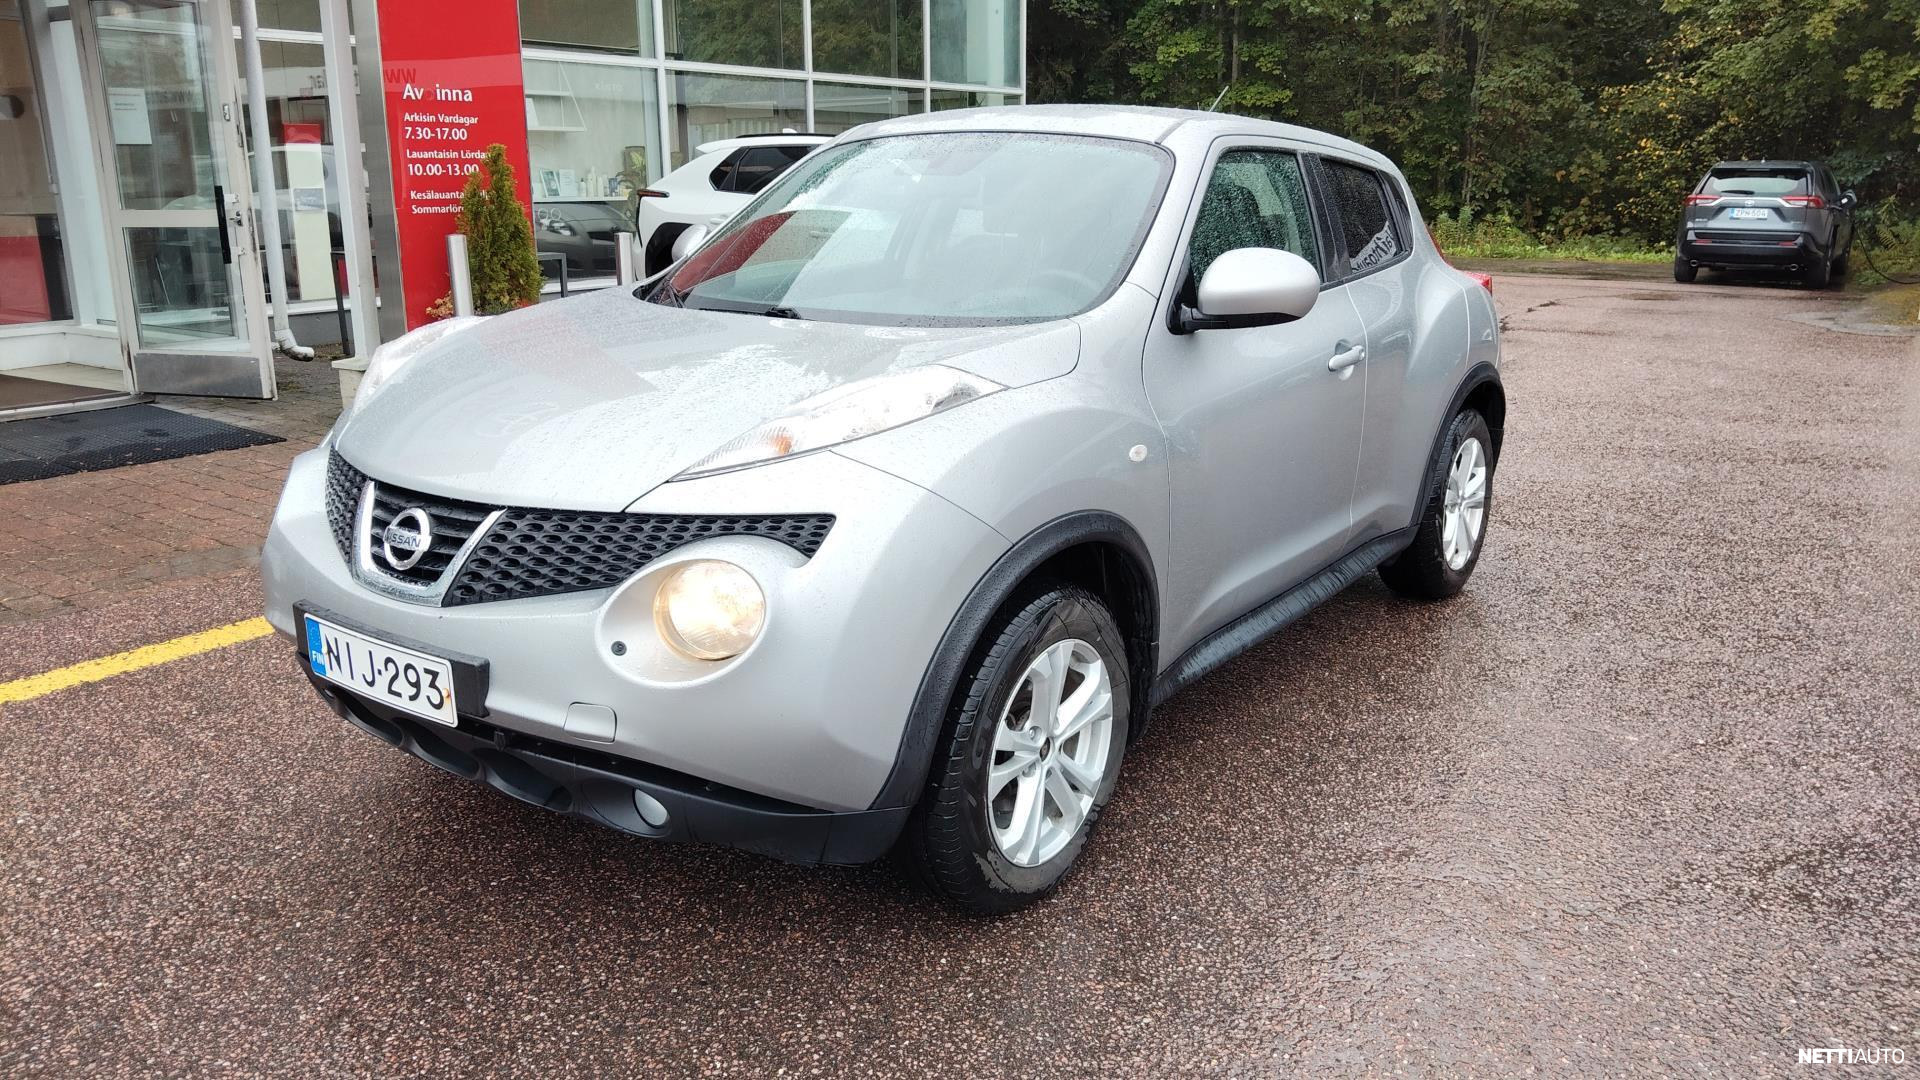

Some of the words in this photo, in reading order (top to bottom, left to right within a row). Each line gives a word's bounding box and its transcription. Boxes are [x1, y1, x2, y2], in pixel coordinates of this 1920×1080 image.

[402, 83, 473, 101] Avinna
[404, 112, 436, 122] Arkisin
[438, 114, 478, 126] Vardagar
[404, 127, 468, 140] 7.30-17.00
[406, 149, 459, 159] Lauantaisin
[408, 163, 479, 176] 10.00-13.00
[410, 190, 465, 200] Kesälauanta
[412, 204, 465, 214] Sommarlör
[384, 531, 421, 548] NISSAN
[312, 650, 325, 665] FIN
[325, 633, 445, 710] NIJ-293
